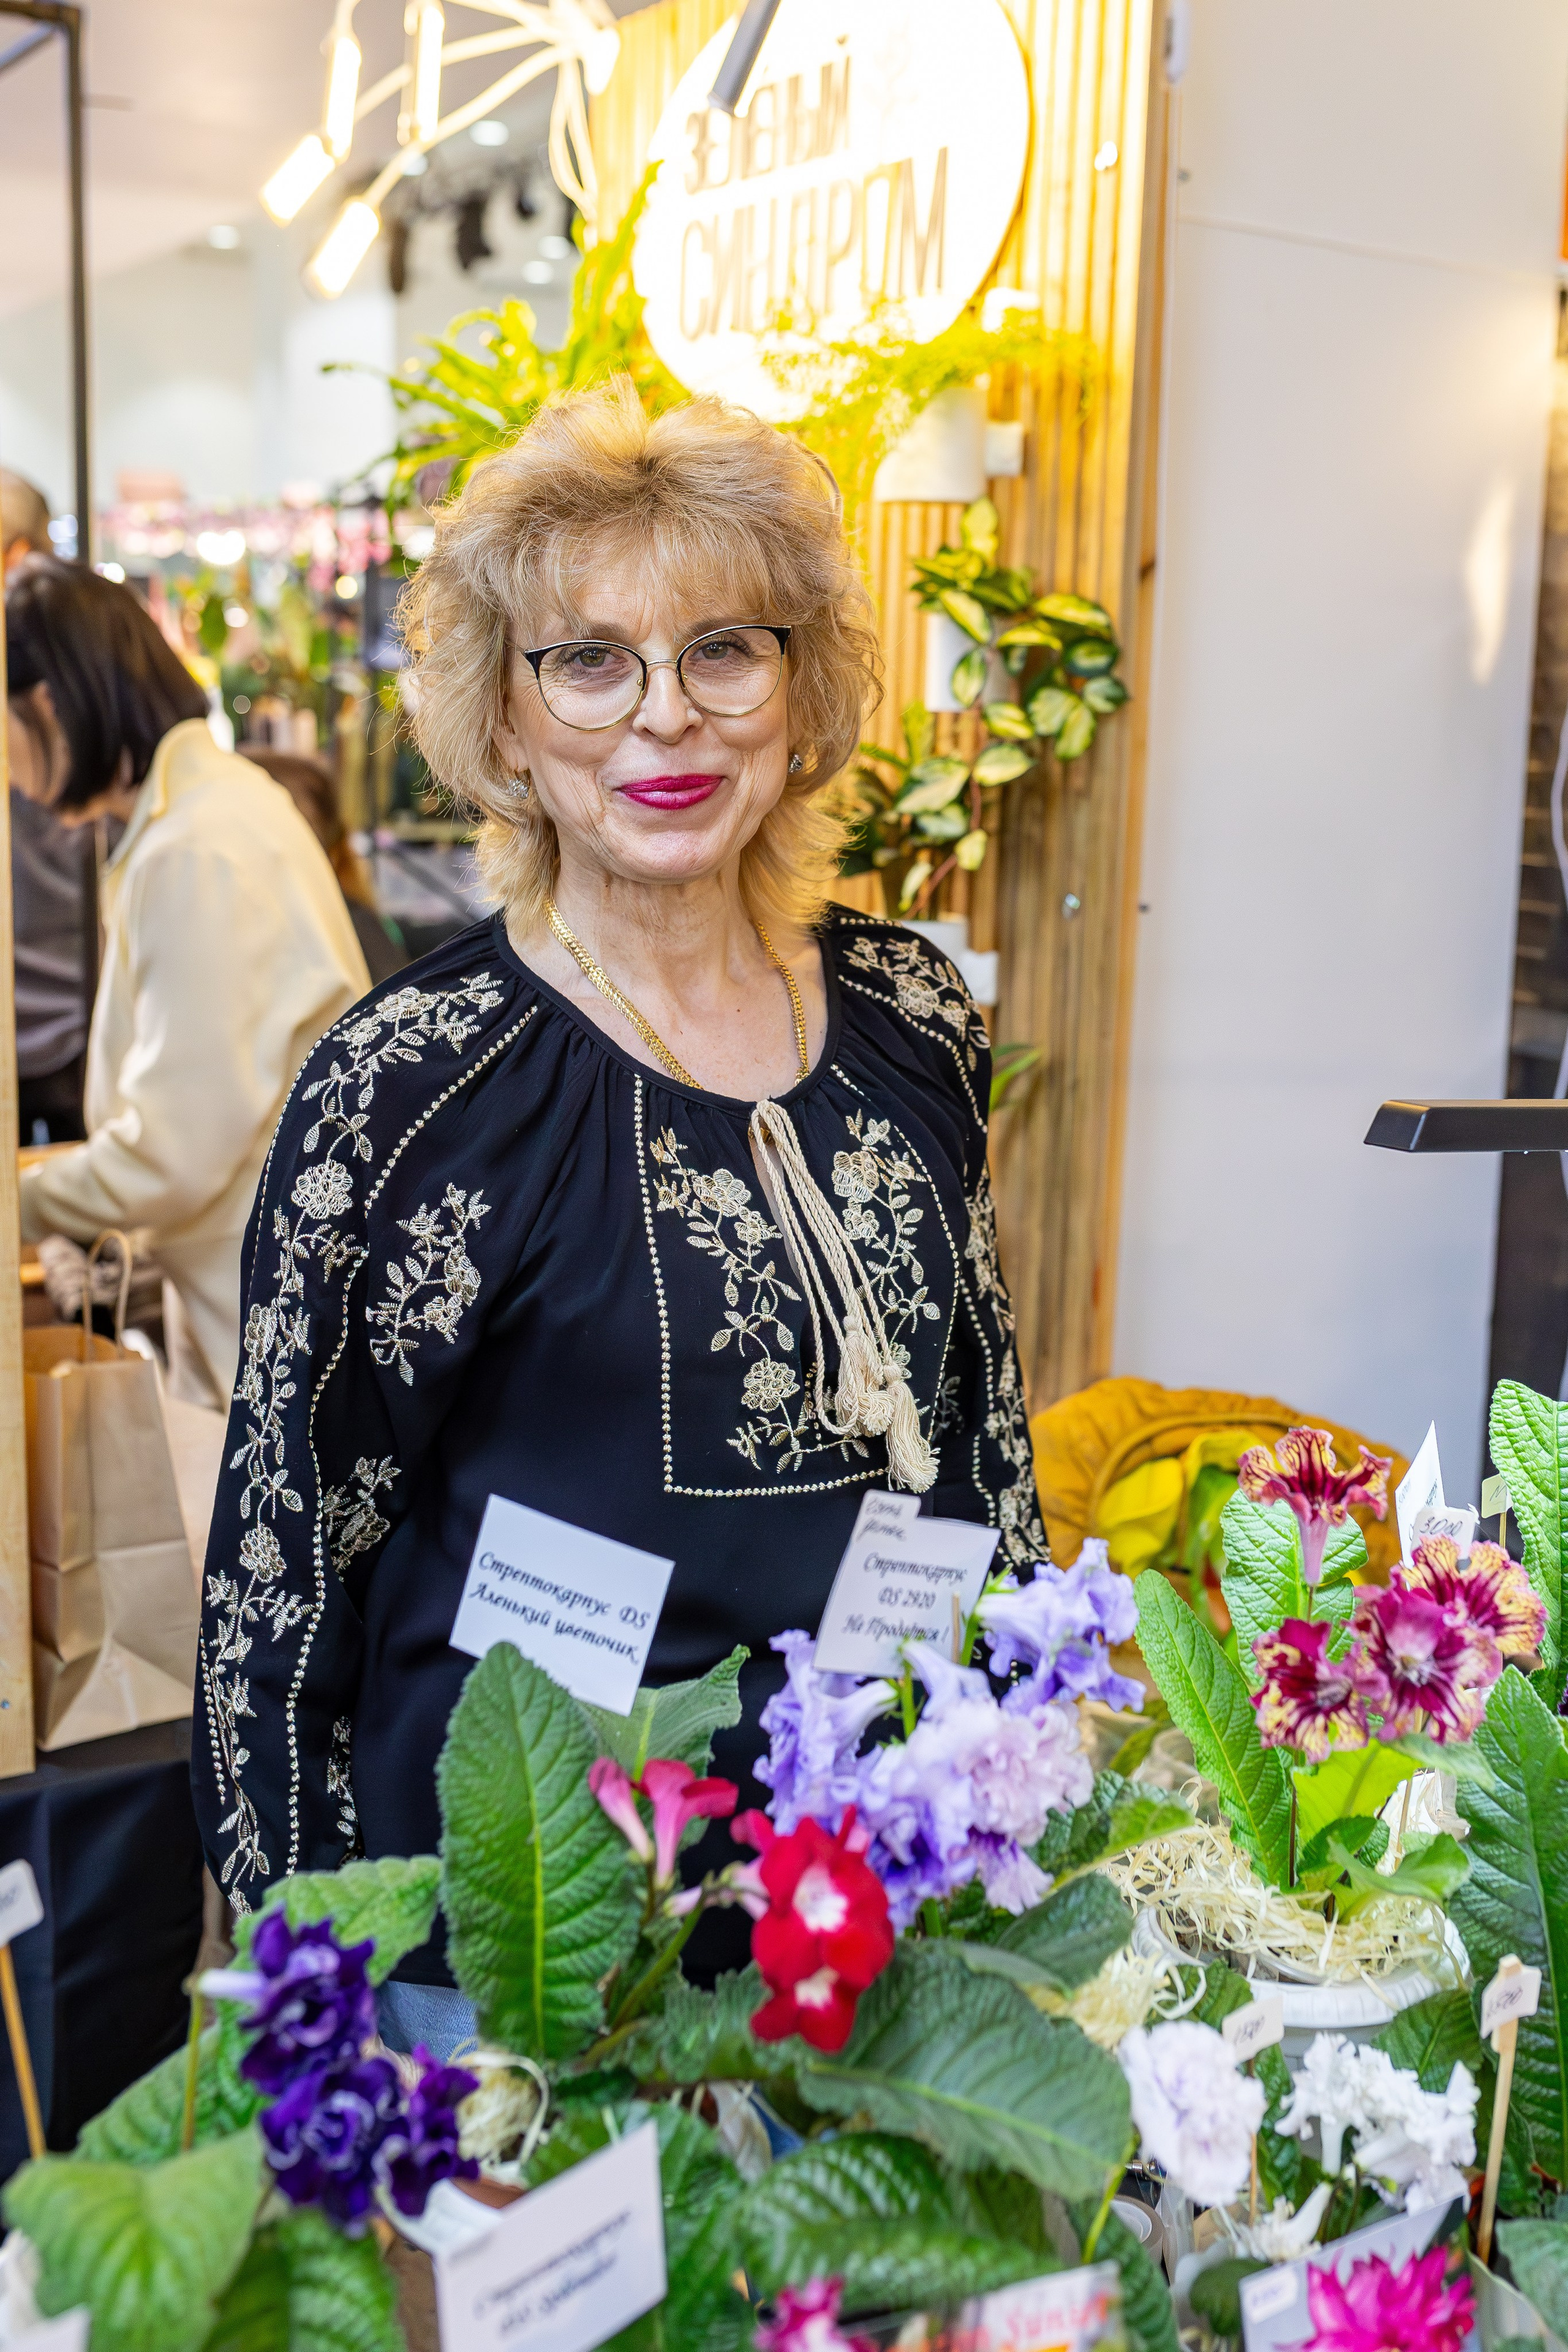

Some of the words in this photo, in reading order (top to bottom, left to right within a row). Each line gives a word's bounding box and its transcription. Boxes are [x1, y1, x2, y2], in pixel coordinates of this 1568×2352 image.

[679, 145, 949, 344] СИНДРОМ
[469, 1582, 552, 1626] Аленький
[479, 1551, 611, 1617] Стрептокарпус
[619, 1606, 650, 1630] DS
